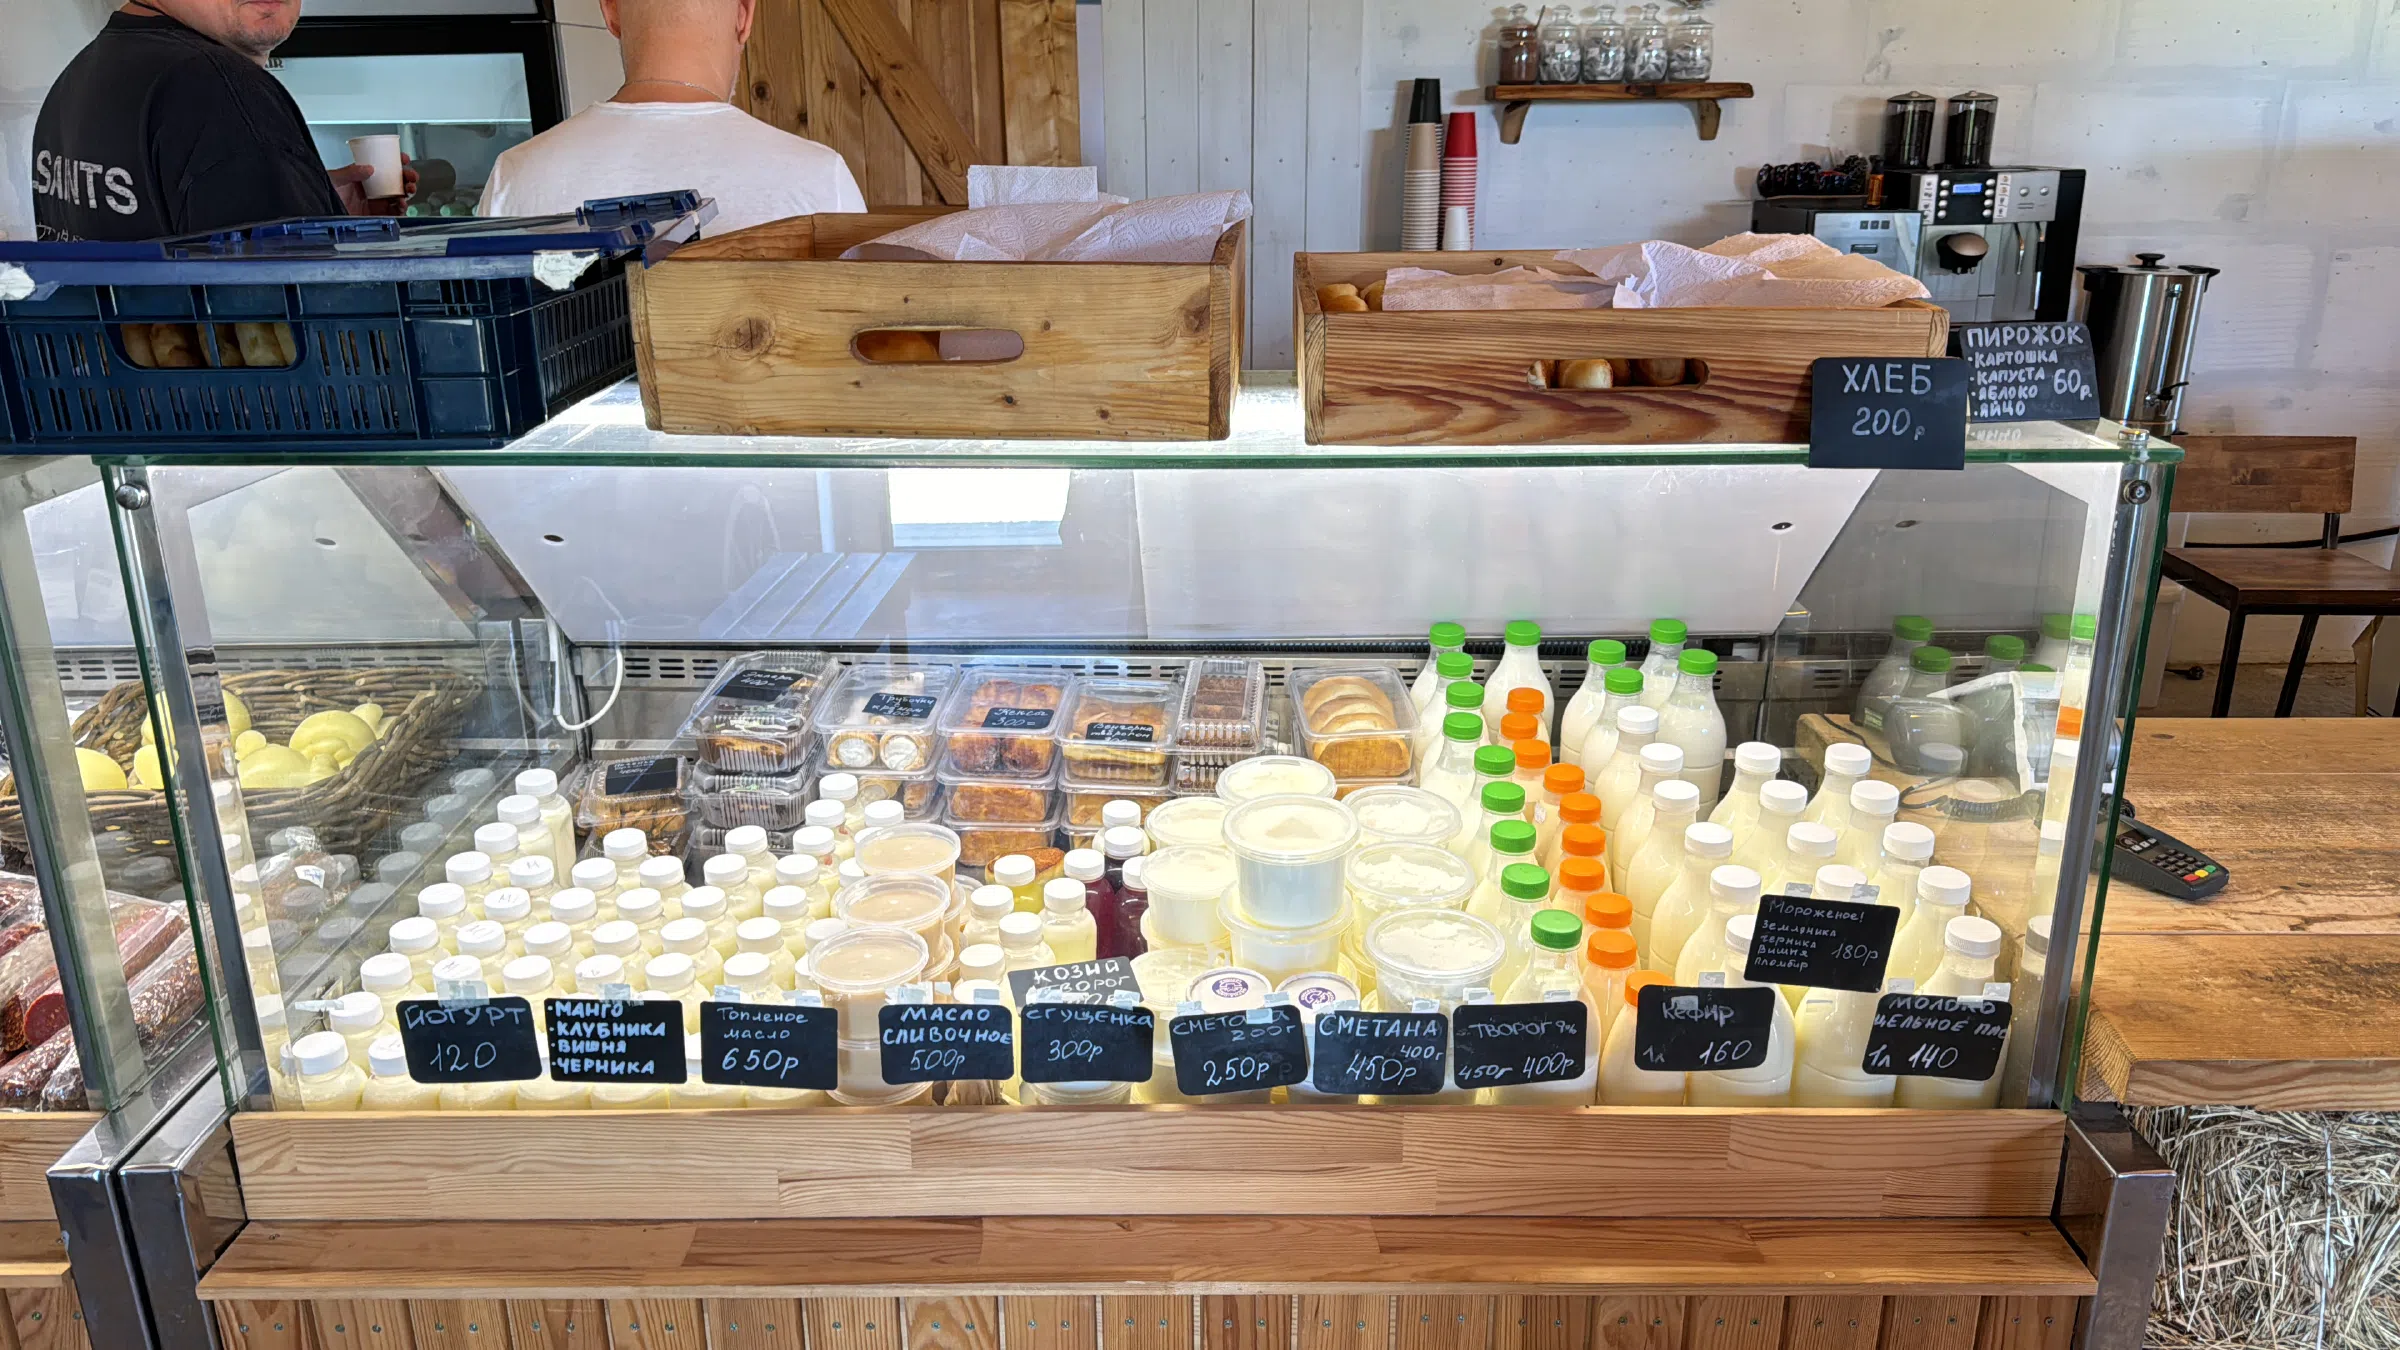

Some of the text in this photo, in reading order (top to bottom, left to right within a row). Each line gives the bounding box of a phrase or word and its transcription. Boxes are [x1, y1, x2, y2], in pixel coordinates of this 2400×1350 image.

[32, 150, 138, 215] SANTS
[1967, 325, 2084, 348] ПИРОЖОК
[1974, 350, 2058, 368] КАРТОШКА
[1842, 363, 1932, 396] ХЛЕБ
[1977, 366, 2045, 385] КАПУСТА
[1978, 384, 2038, 400] ЯБЛОКО
[1979, 400, 2026, 418] ЯЙЦО
[1768, 900, 1865, 923] Мороженое!
[555, 1000, 624, 1019] МАНГО
[717, 1006, 809, 1024] Топленое
[900, 1006, 992, 1023] МАСЛО
[556, 1020, 666, 1039] КЛУБНИКА
[1319, 1014, 1438, 1038] СМЕТАНА
[1468, 1021, 1553, 1039] ТВОРОГ
[1873, 1013, 1969, 1032] ЦЕЛЬНОЕ
[724, 1027, 790, 1040] масло
[883, 1027, 1014, 1046] СЛИВОЧНОЕ
[429, 1041, 497, 1072] 120
[557, 1039, 627, 1054] ВИШНЯ
[1047, 1040, 1104, 1063] 300р
[1699, 1040, 1753, 1065] 160
[1868, 1043, 1959, 1069] 1л 140
[556, 1057, 656, 1075] ЧЕРНИКА
[721, 1047, 799, 1081] 650р
[909, 1048, 966, 1076] 500р
[1202, 1056, 1270, 1087] 250р
[1346, 1053, 1418, 1086] 450р
[1522, 1051, 1575, 1079] 400р
